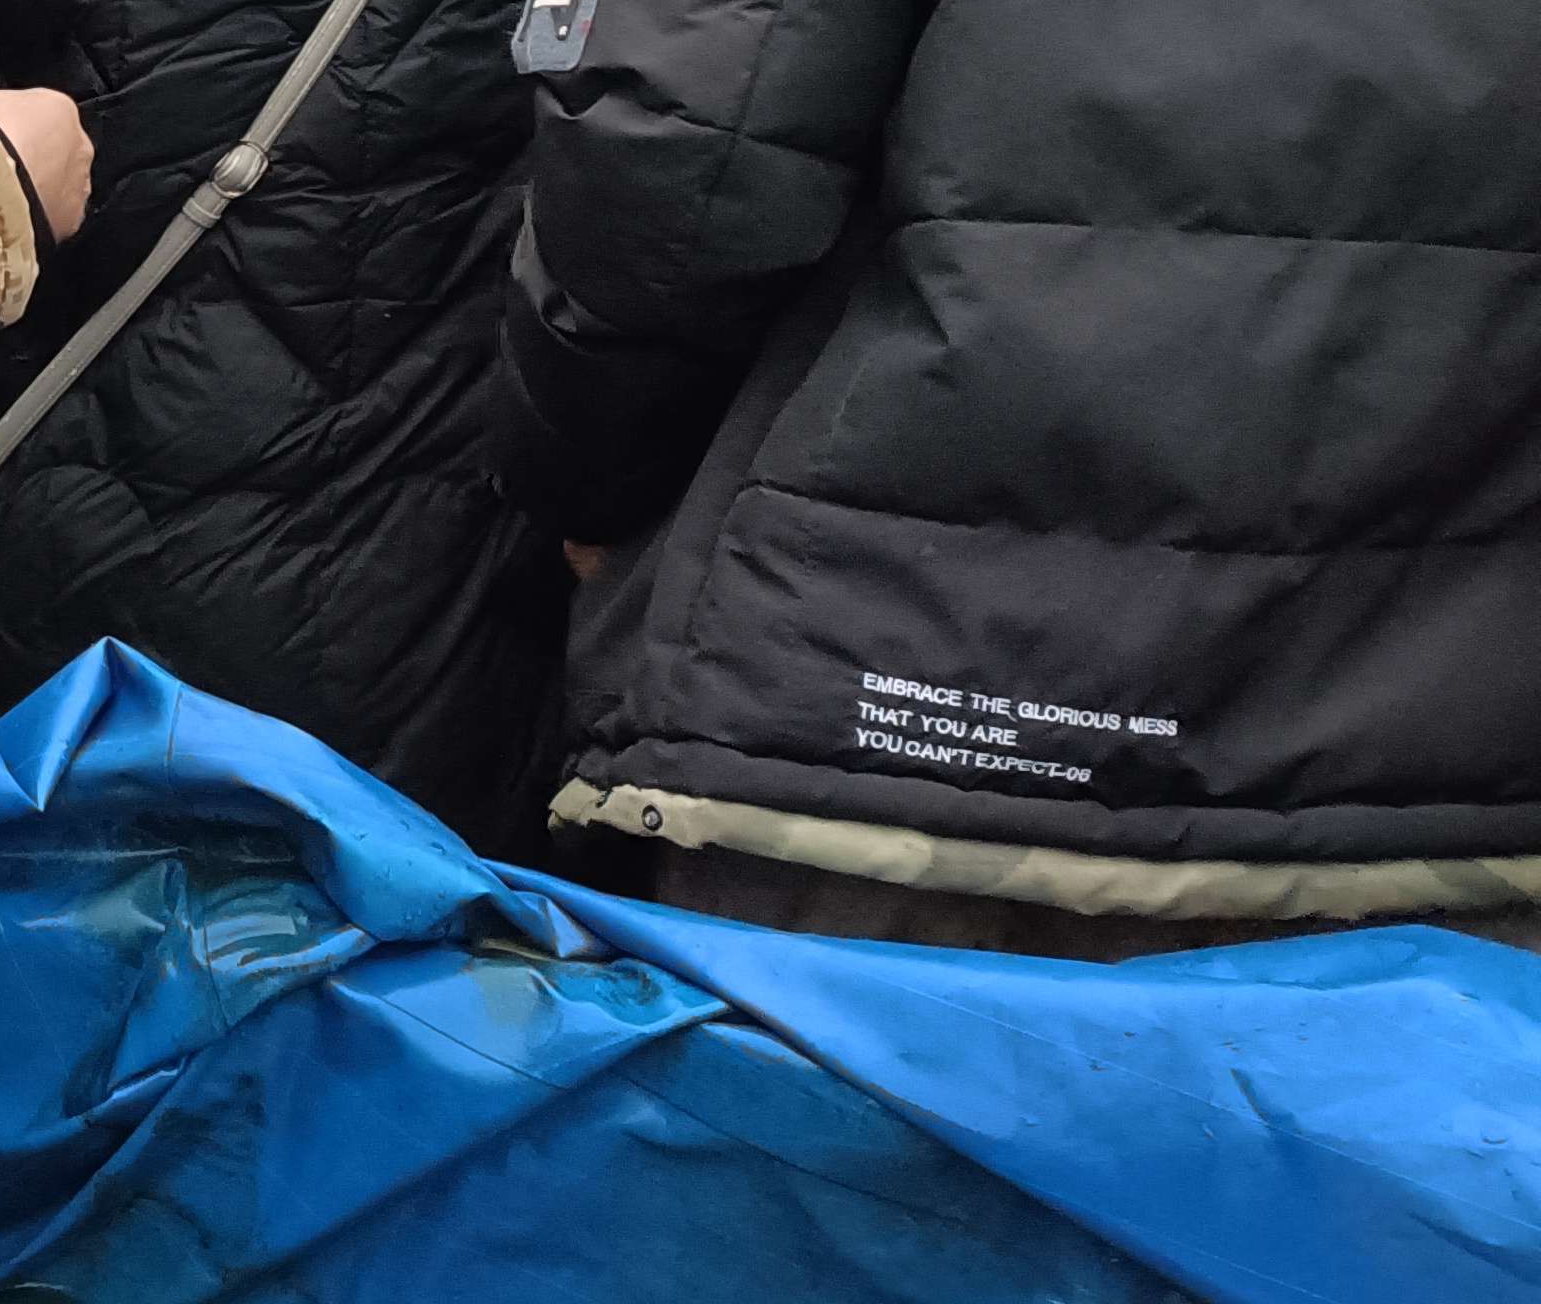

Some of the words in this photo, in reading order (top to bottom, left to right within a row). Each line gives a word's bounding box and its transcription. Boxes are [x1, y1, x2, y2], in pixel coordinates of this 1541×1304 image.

[857, 700, 914, 727] THAT
[920, 714, 968, 738] YOU
[971, 725, 1019, 746] ARE
[863, 672, 964, 707] EMBRACE
[970, 693, 1012, 715] THE
[1018, 701, 1121, 731] GLORIOUS
[1128, 716, 1178, 736] MESS
[855, 727, 903, 753] YOU
